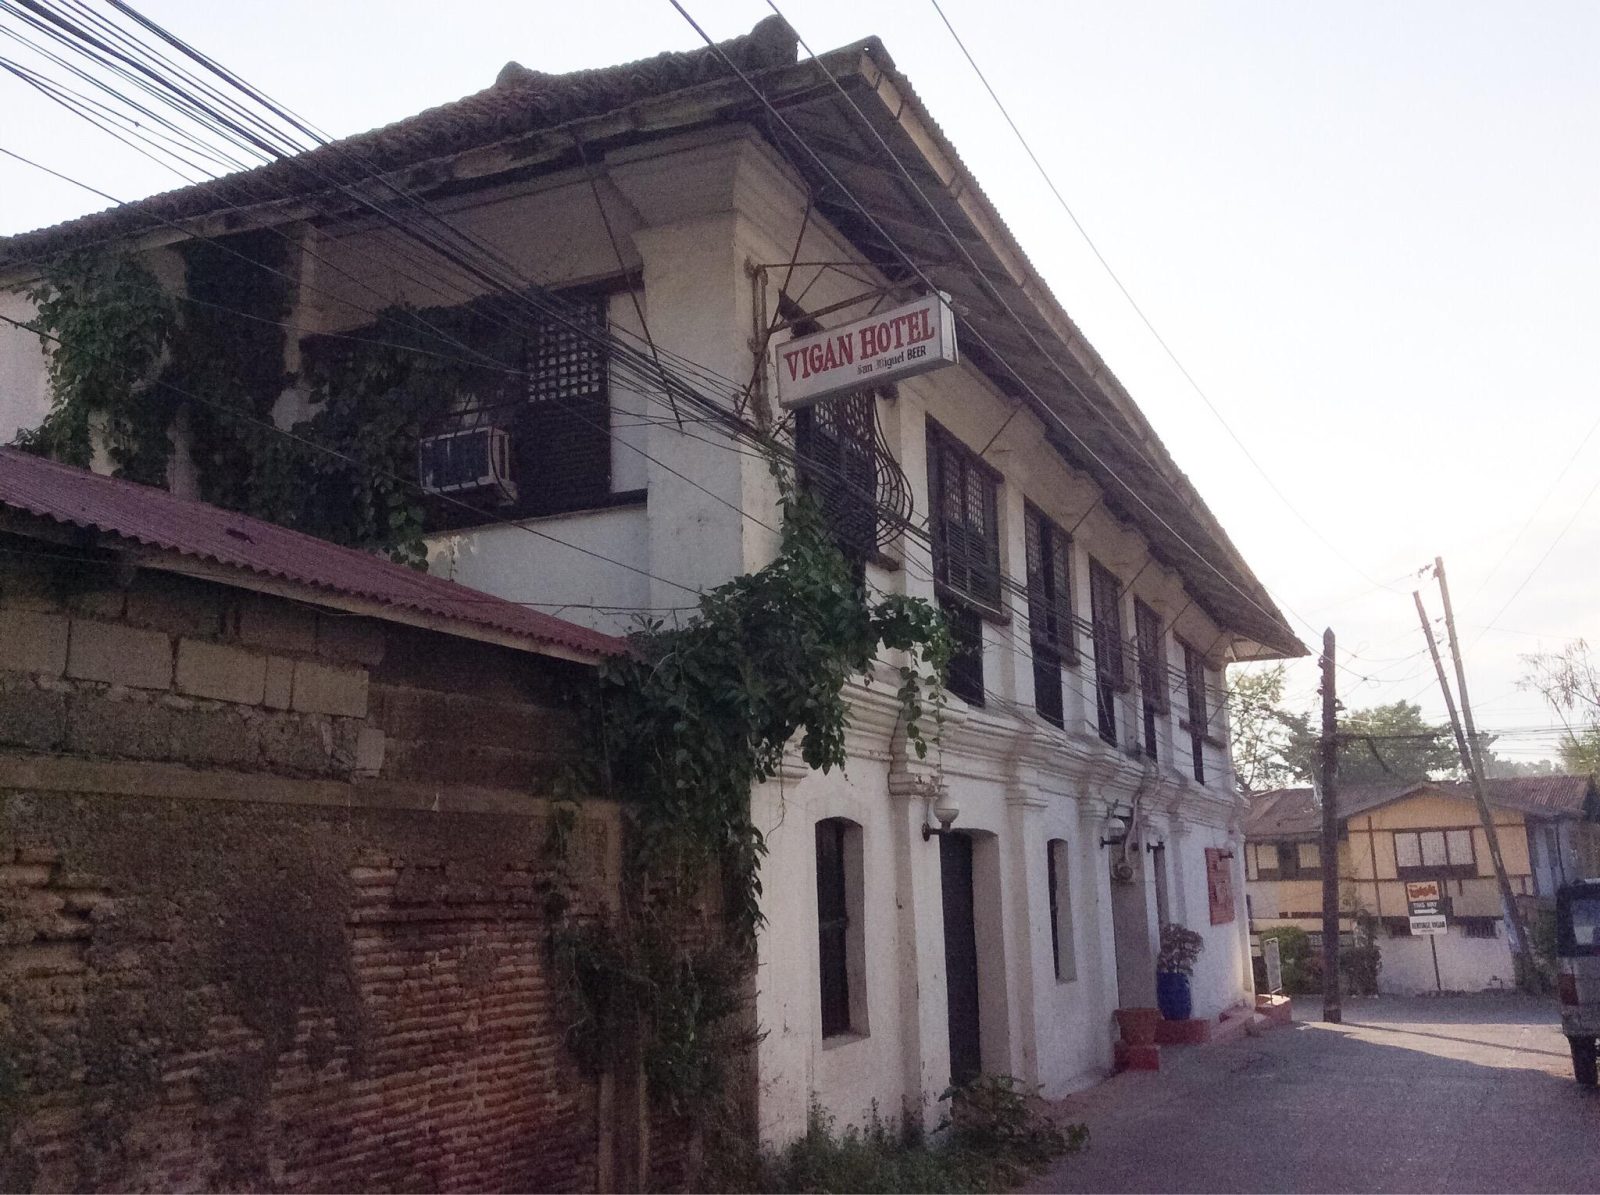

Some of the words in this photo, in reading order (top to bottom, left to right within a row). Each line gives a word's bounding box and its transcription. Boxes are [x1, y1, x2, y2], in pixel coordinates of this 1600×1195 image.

[783, 332, 853, 382] VIGAN
[859, 308, 935, 360] HOTEL
[857, 363, 873, 375] San
[876, 351, 905, 370] Miguel
[907, 345, 927, 361] BEER
